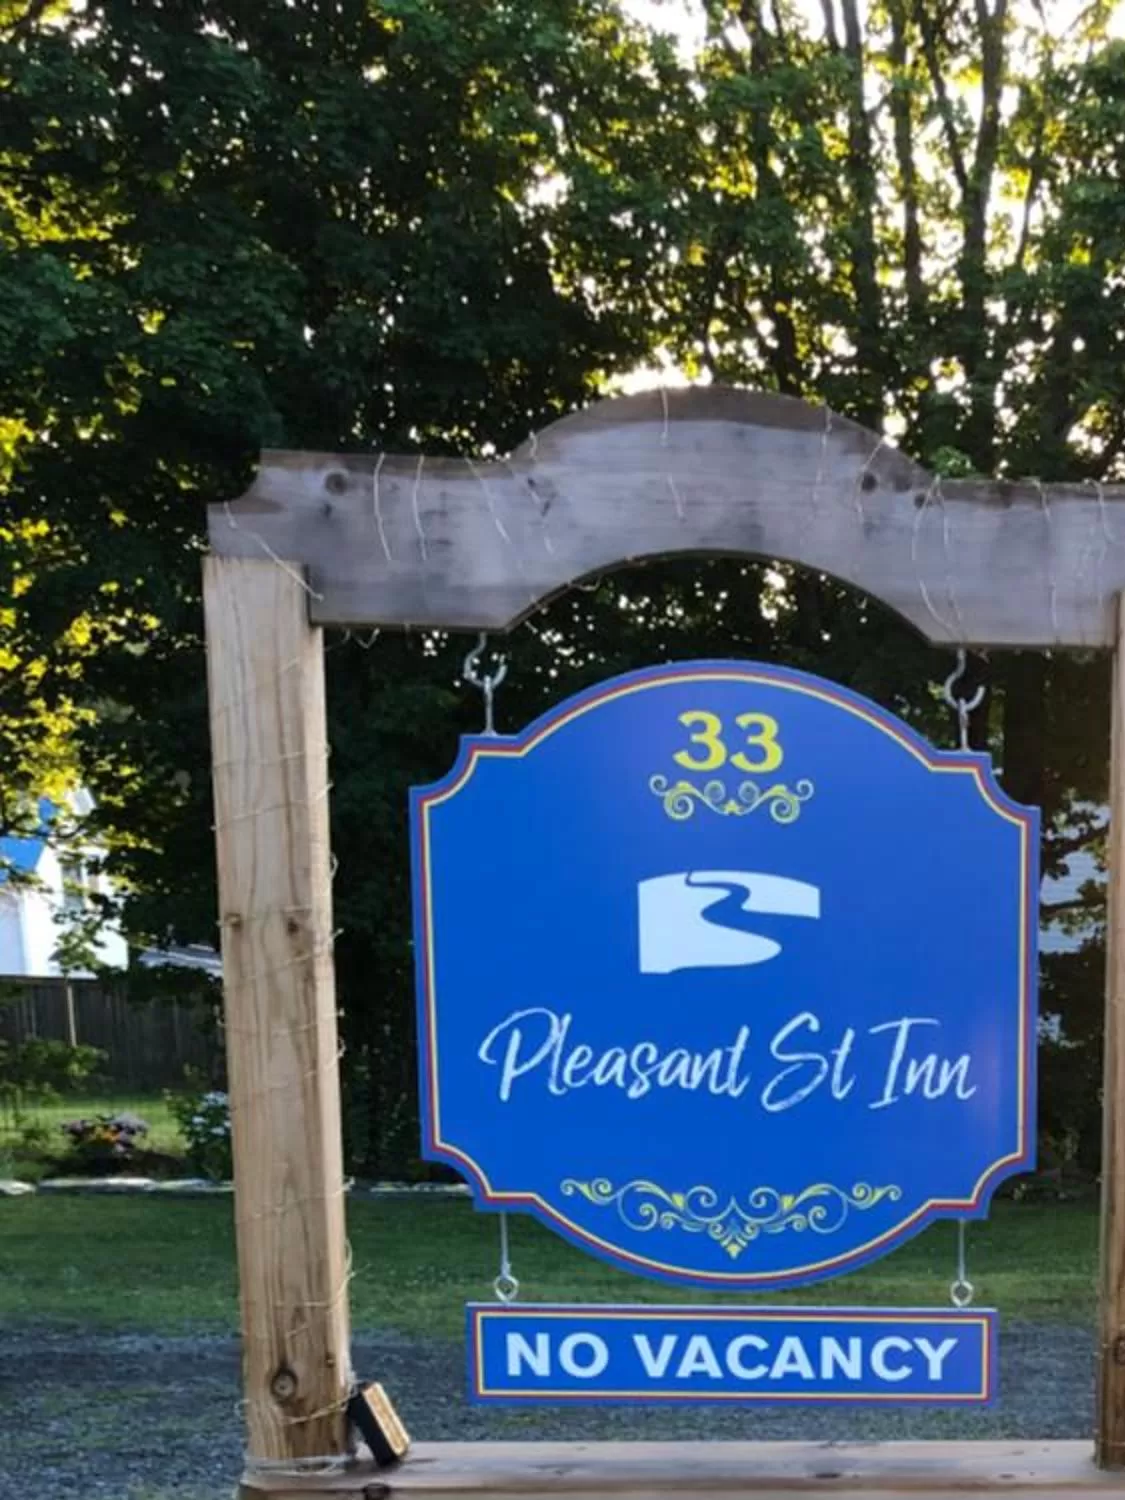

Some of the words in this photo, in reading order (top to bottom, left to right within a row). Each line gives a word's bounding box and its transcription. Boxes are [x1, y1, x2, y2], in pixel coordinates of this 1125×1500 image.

[673, 710, 783, 773] 33
[478, 1008, 750, 1101] Pleasant
[761, 1011, 855, 1112] St
[868, 1017, 977, 1110] Inn
[507, 1333, 608, 1378] NO
[633, 1335, 958, 1381] VACANCY
